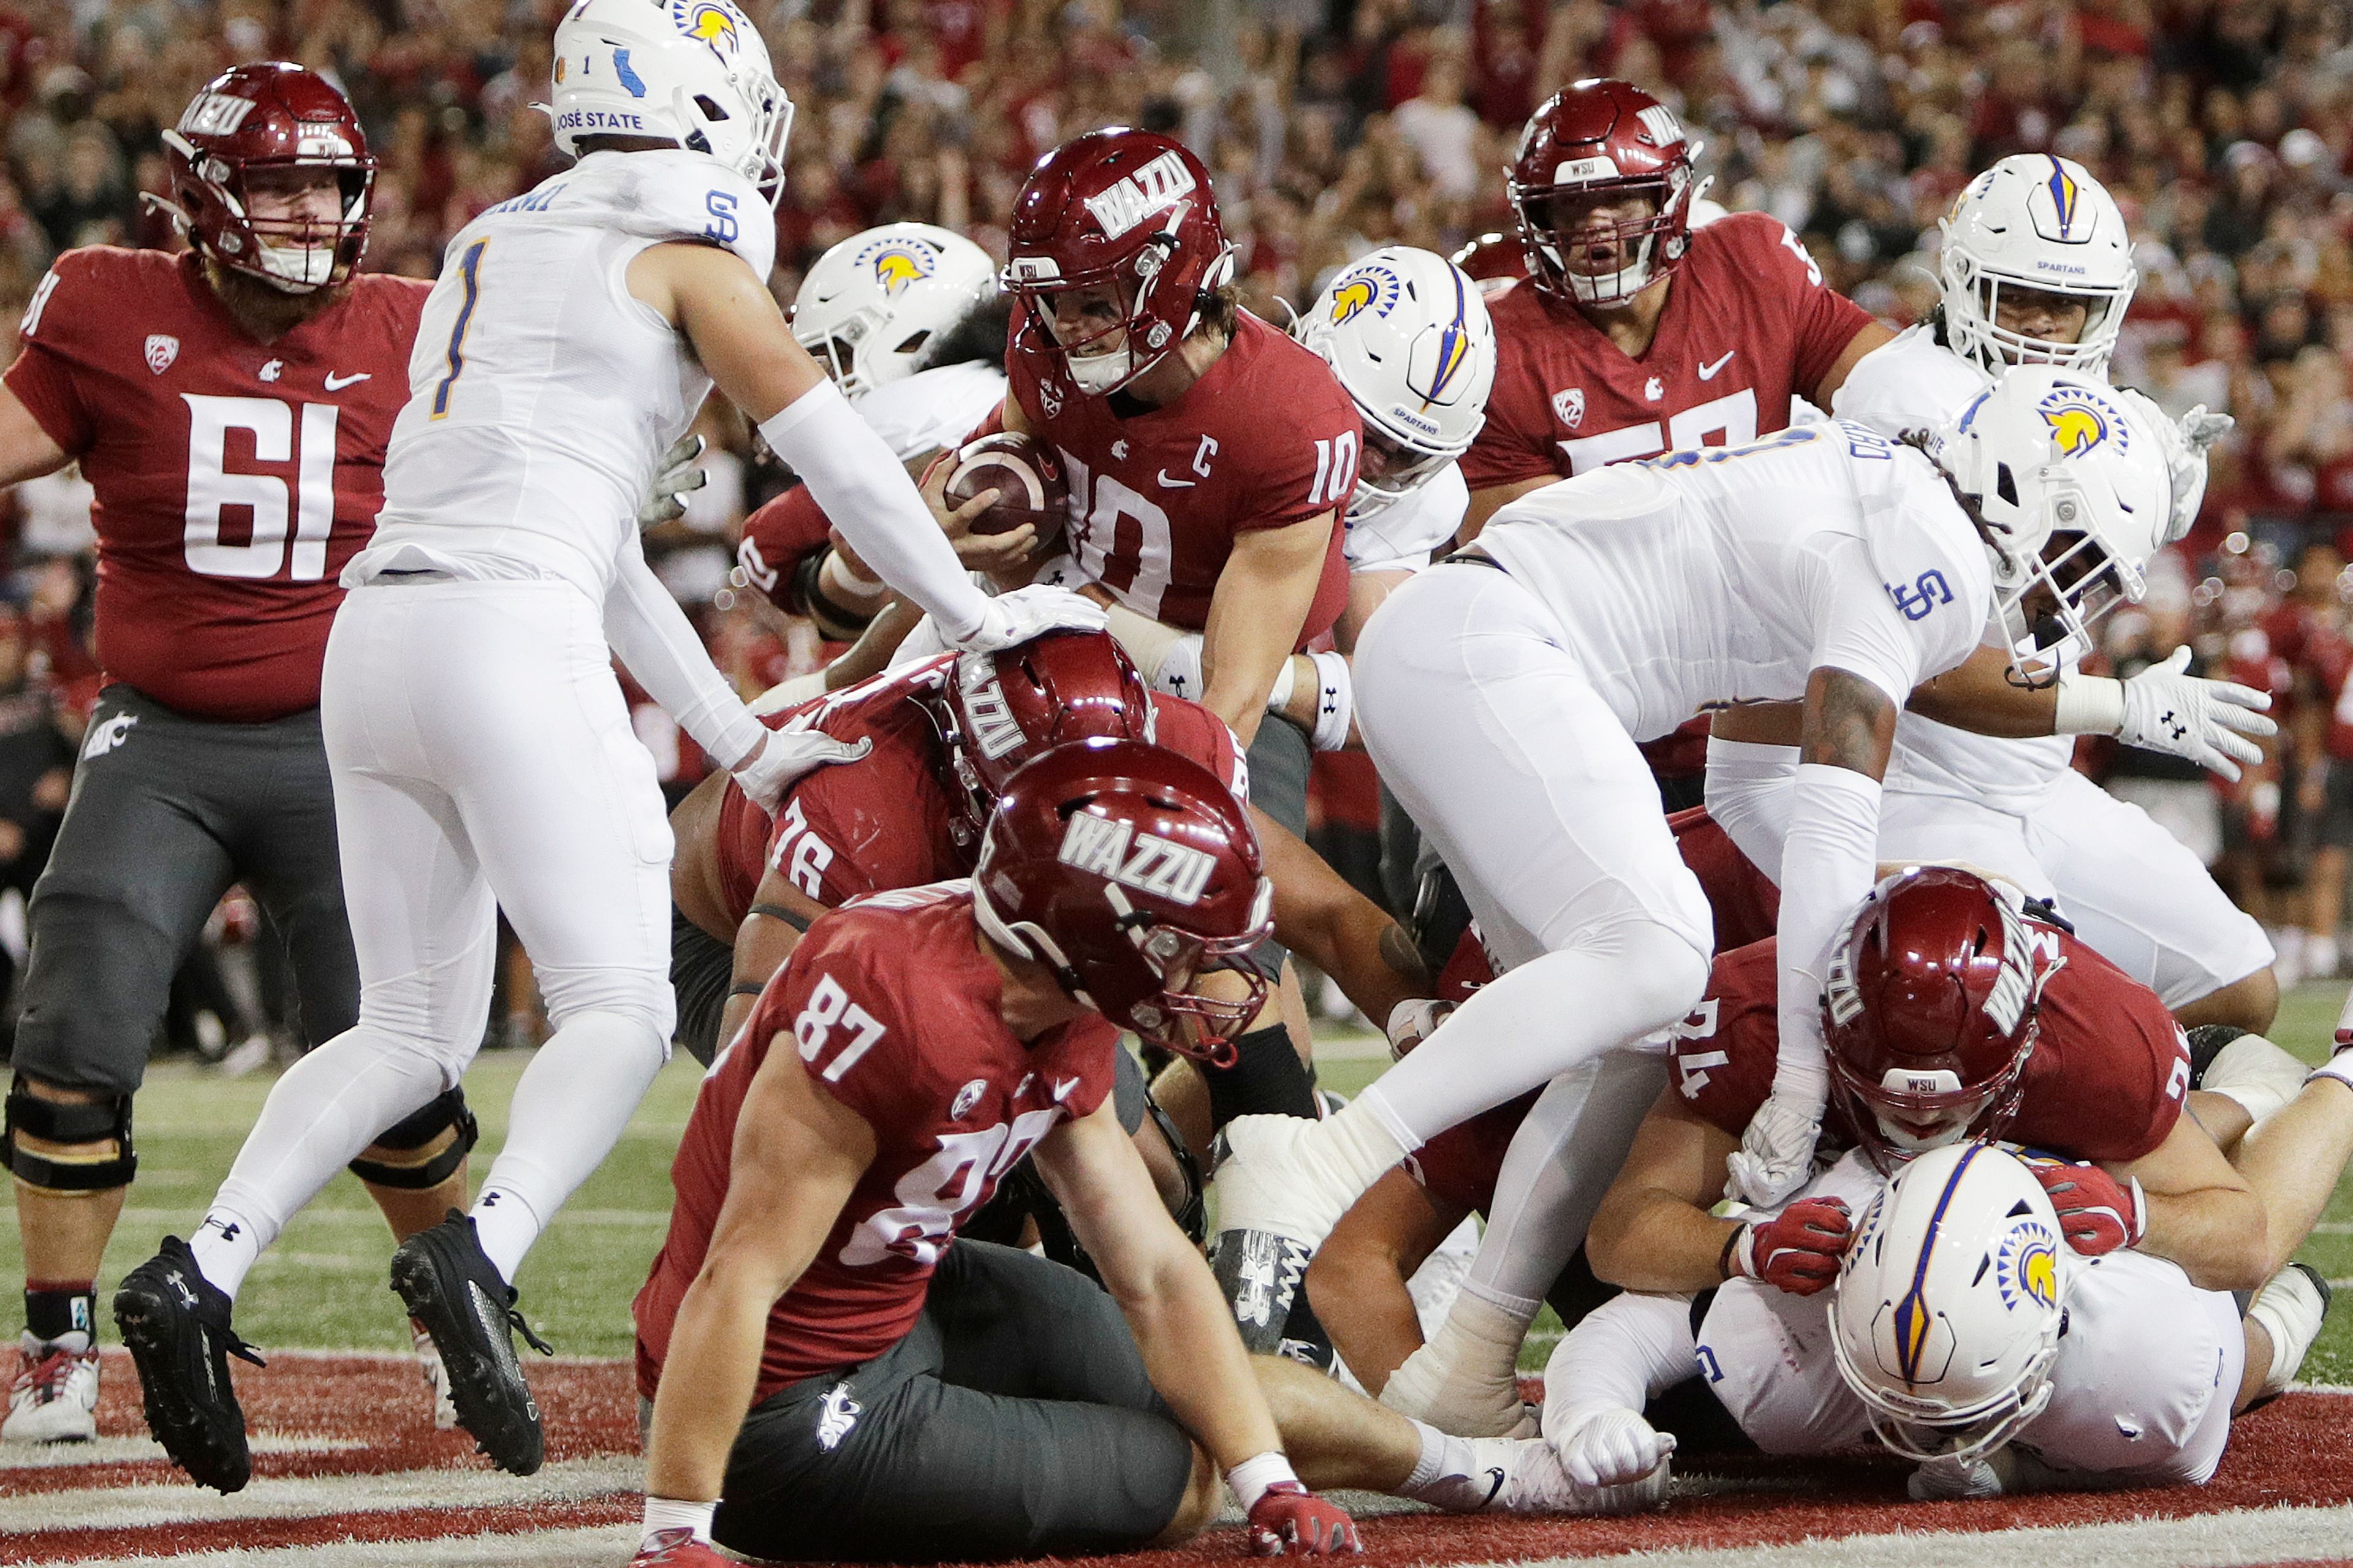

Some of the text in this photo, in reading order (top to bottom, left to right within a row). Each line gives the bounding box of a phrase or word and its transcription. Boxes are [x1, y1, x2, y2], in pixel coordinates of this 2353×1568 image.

[583, 55, 590, 74] 1
[558, 108, 644, 131] JOSÉ STATE
[1571, 162, 1595, 176] WSU
[1083, 149, 1197, 241] WAZZU
[2037, 261, 2086, 275] SPARTANS
[429, 235, 491, 422] 1
[1393, 407, 1439, 436] SPARTANS
[1564, 404, 1580, 422] 12
[1192, 433, 1219, 478] C
[1307, 429, 1357, 504] 10
[179, 392, 339, 581] 61
[770, 796, 835, 900] 76
[1057, 809, 1219, 906] WAZZU
[794, 972, 887, 1082] 87
[1908, 1077, 1937, 1092] WSU
